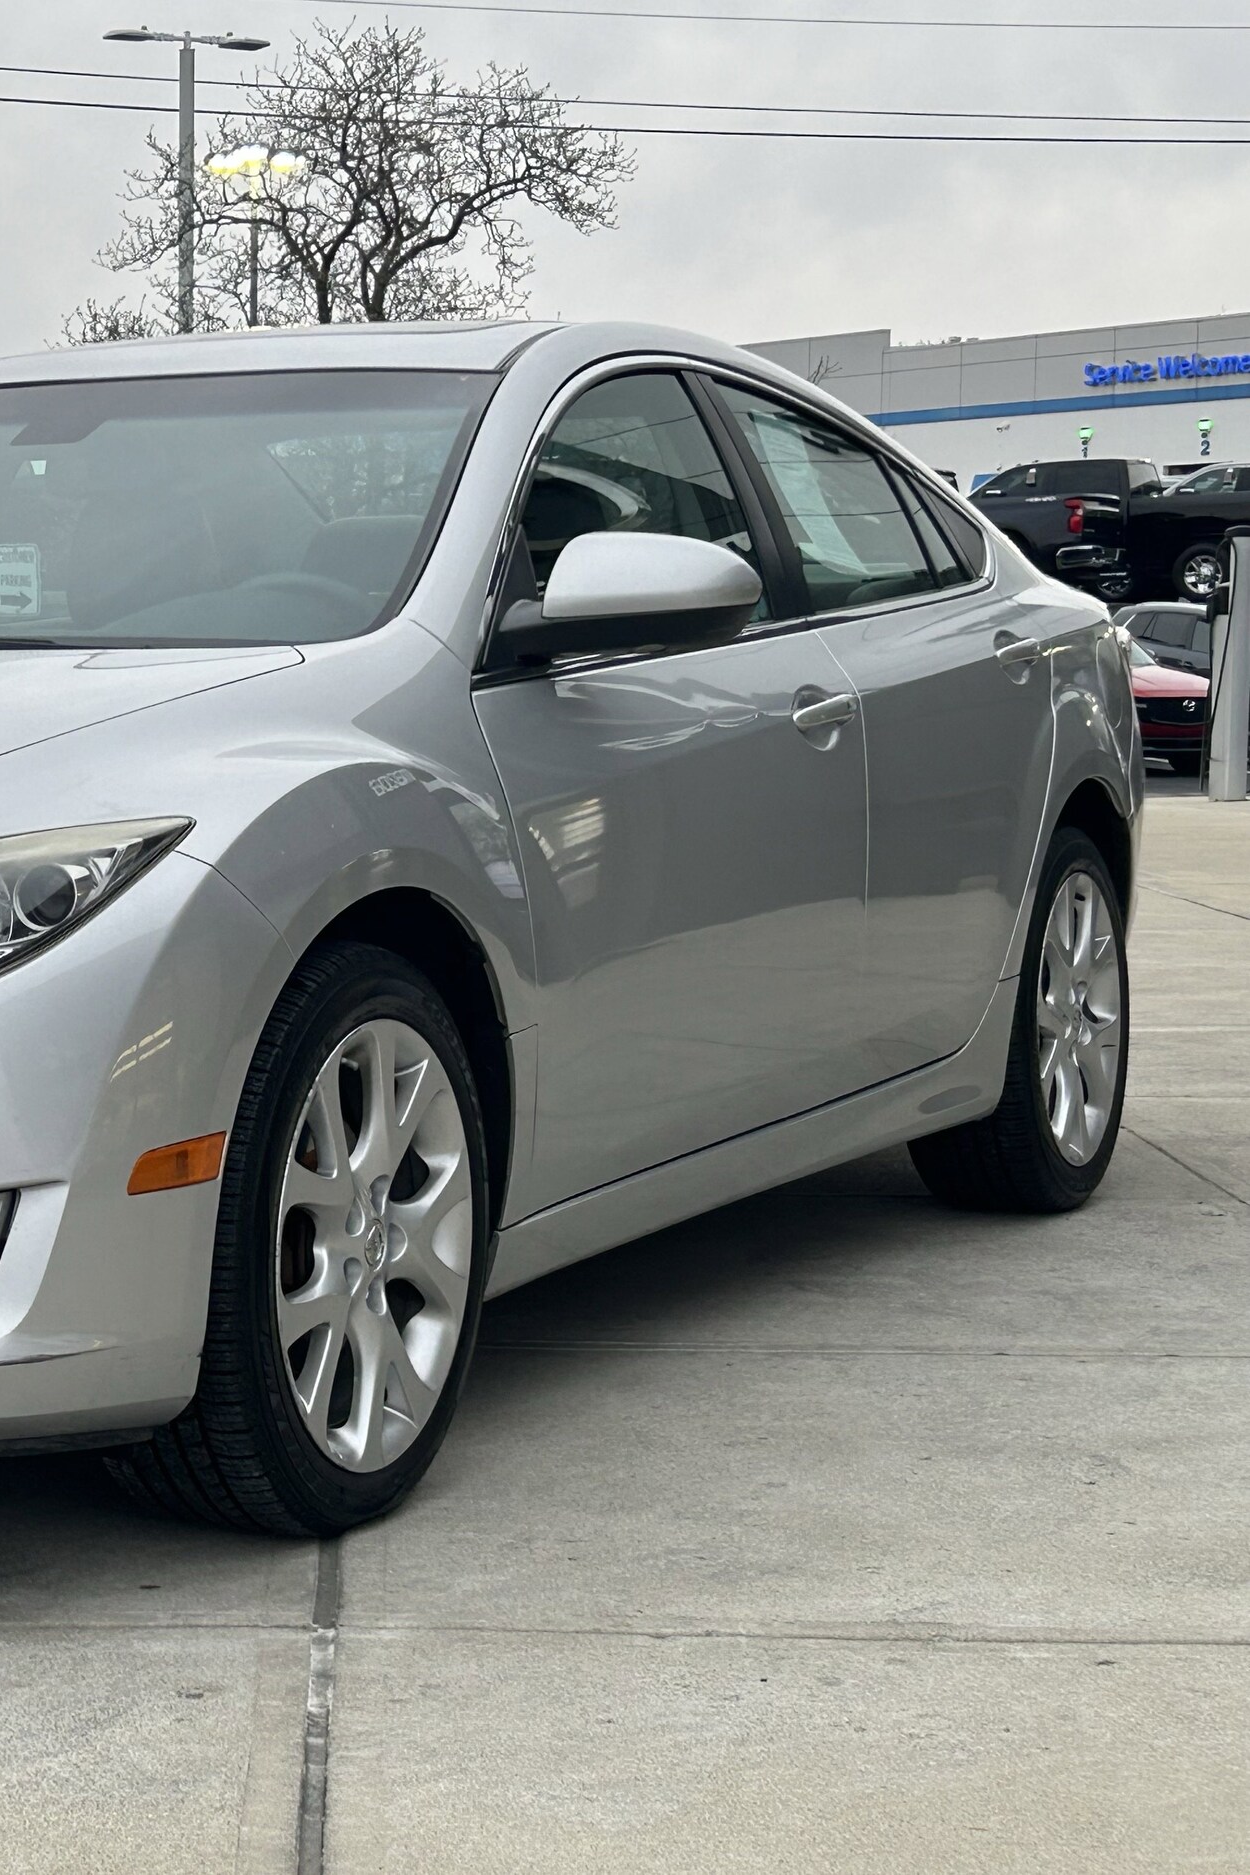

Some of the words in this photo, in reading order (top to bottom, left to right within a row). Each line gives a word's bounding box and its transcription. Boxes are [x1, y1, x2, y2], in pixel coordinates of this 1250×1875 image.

[1084, 360, 1156, 387] Service
[1158, 353, 1250, 379] Welcome
[1081, 447, 1088, 458] 1
[1200, 440, 1211, 456] 2
[0, 574, 32, 587] PARKING
